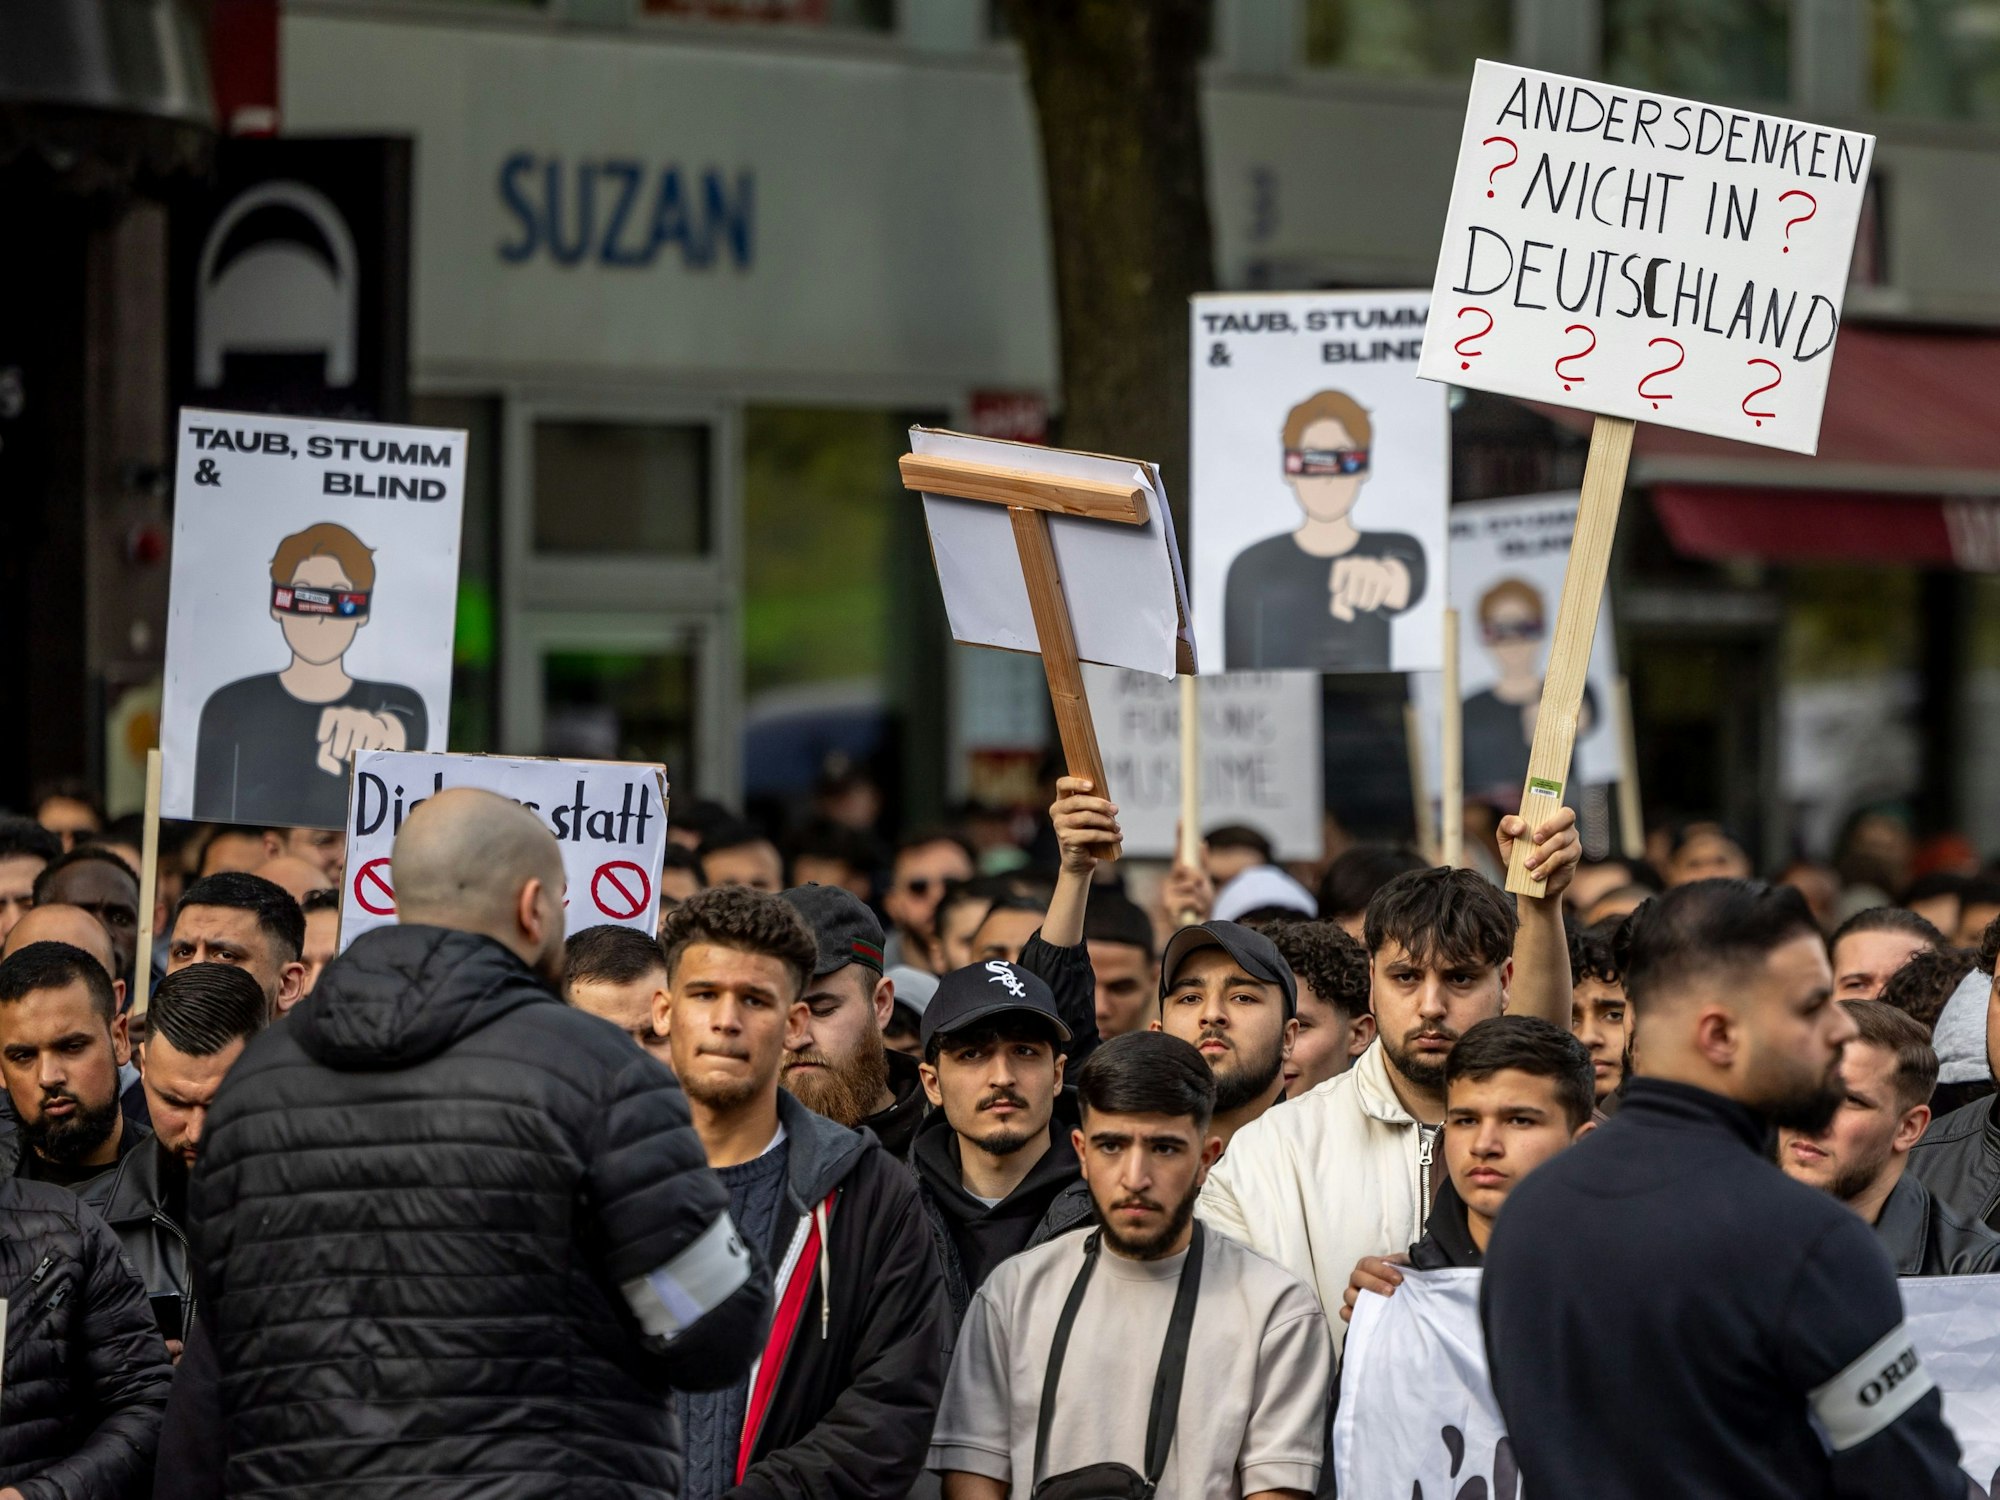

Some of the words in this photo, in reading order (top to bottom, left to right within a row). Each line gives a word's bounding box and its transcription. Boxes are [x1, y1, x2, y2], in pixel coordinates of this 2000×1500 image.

[1496, 77, 1866, 184] ANDERSDENKEN
[499, 151, 756, 269] SUZAN
[1483, 136, 1518, 199] ?
[1521, 152, 1685, 234] NICHT
[1705, 181, 1758, 242] IN
[1779, 190, 1817, 254] ?
[1203, 312, 1298, 335] TAUB,
[1452, 226, 1839, 362] DEUTSCHLAND
[1208, 343, 1231, 367] &
[1454, 306, 1494, 371] ?
[1555, 324, 1597, 392] ?
[1638, 337, 1686, 410] ?
[1742, 359, 1782, 427] ?
[188, 427, 298, 460] TAUB,
[306, 436, 452, 468] STUMM
[194, 458, 221, 487] &
[322, 471, 447, 503] BLIND
[548, 780, 654, 844] statt
